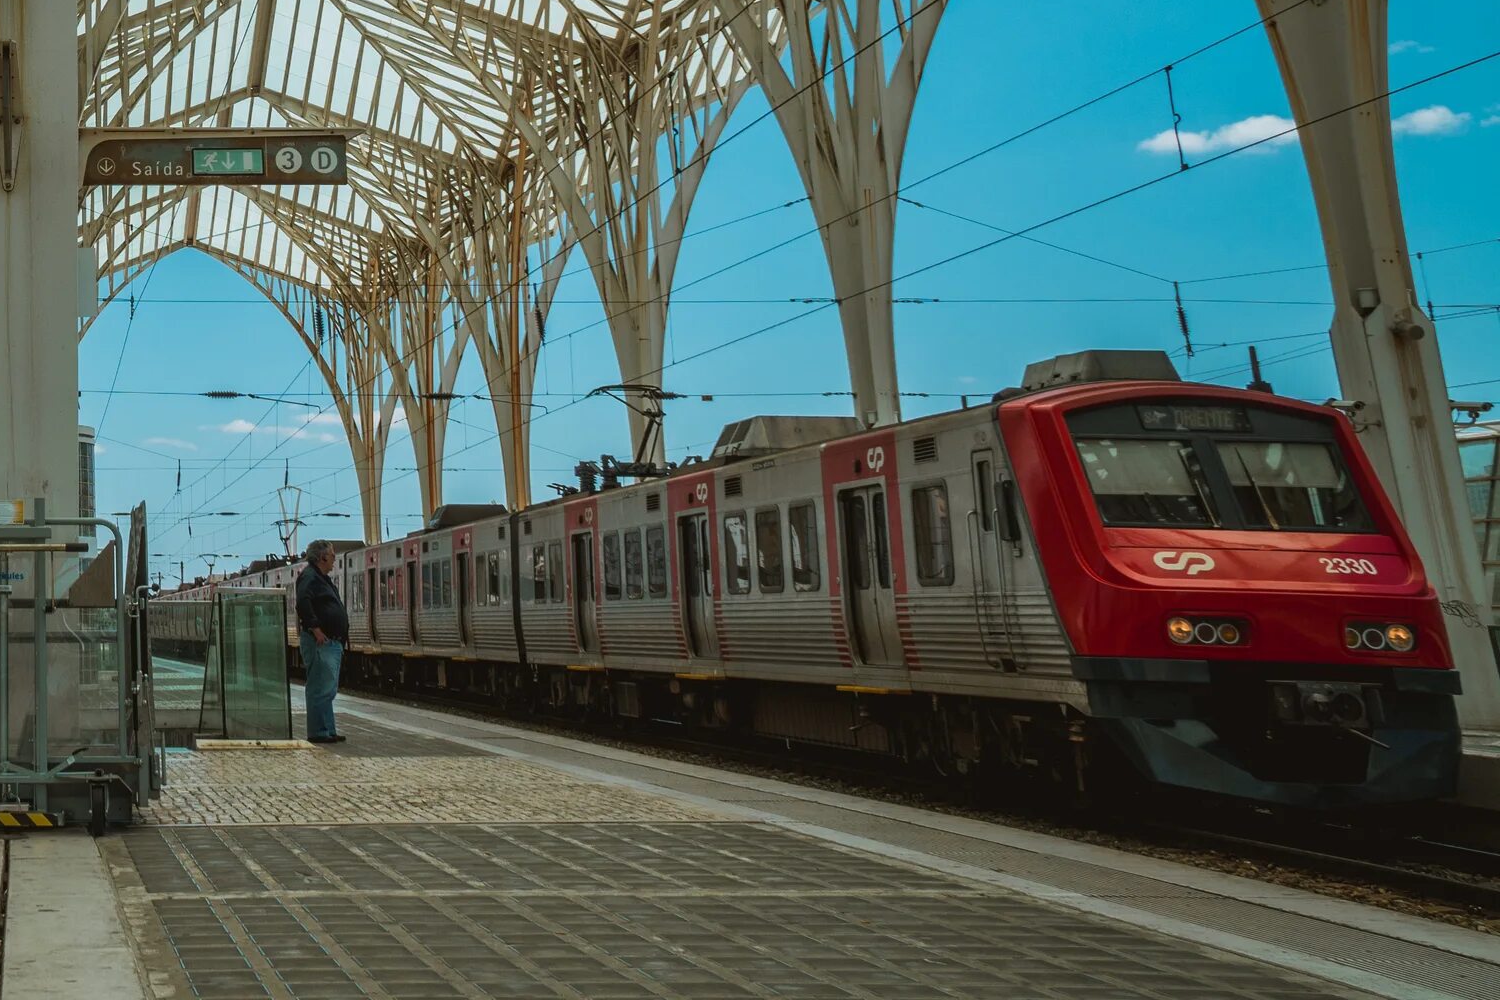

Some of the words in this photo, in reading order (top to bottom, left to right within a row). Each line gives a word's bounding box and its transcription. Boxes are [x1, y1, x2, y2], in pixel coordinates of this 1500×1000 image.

[132, 161, 183, 176] Saída
[282, 151, 295, 170] 3
[318, 151, 331, 170] D
[1318, 557, 1378, 576] 2330
